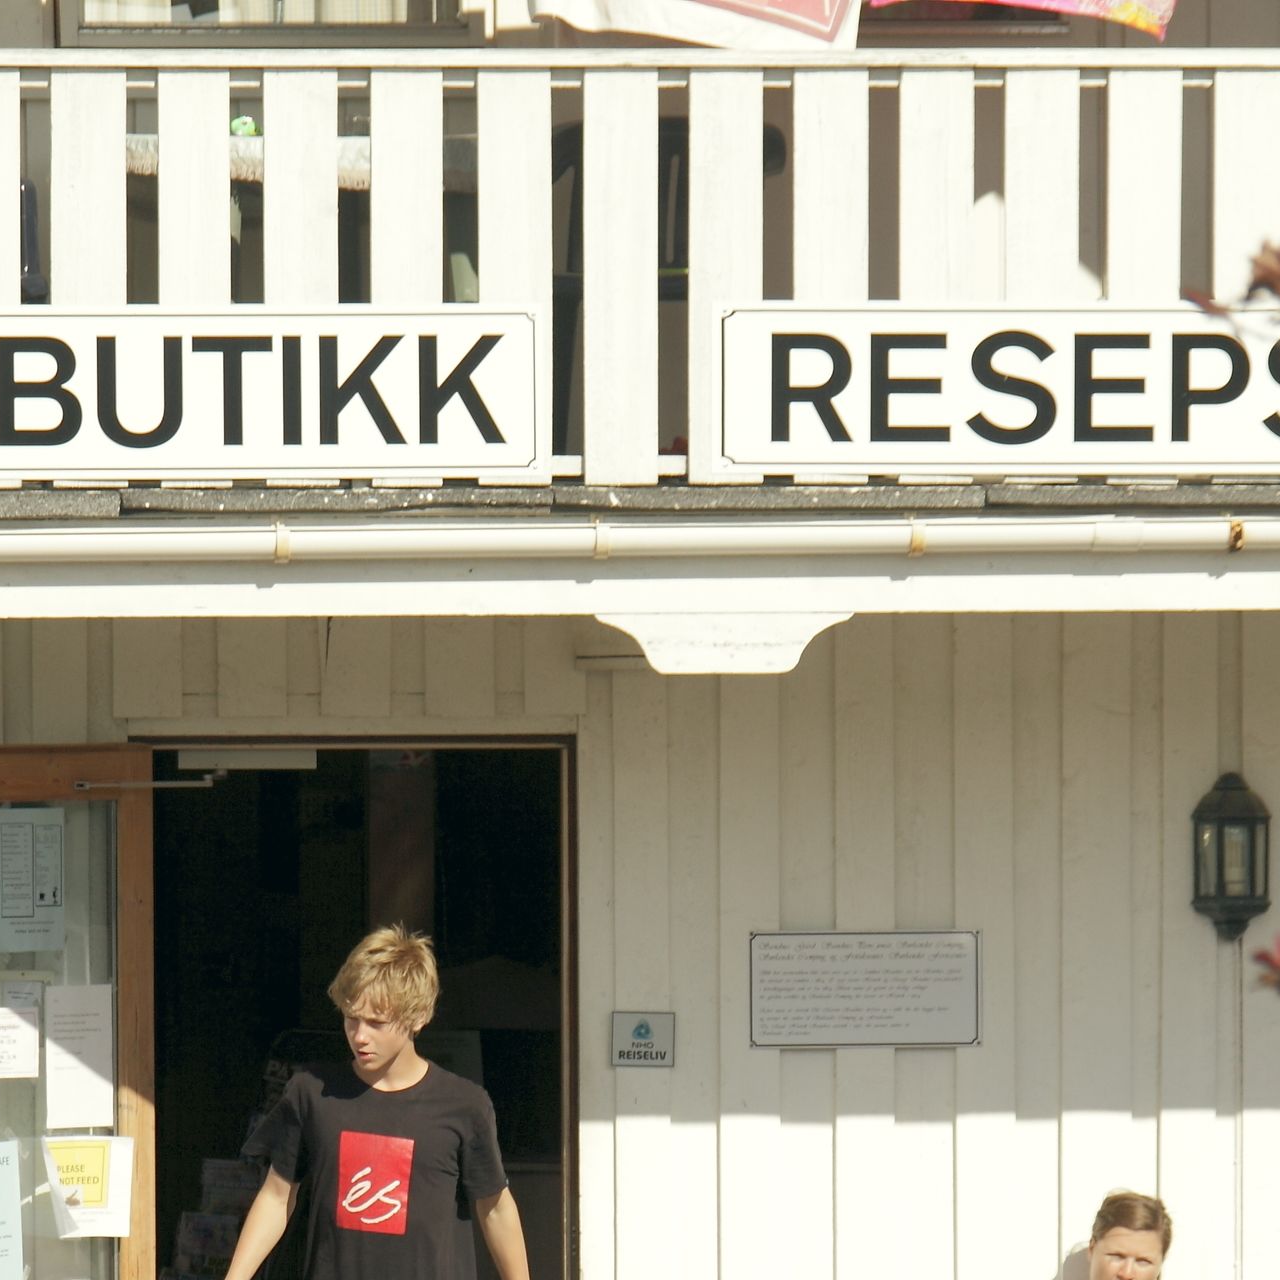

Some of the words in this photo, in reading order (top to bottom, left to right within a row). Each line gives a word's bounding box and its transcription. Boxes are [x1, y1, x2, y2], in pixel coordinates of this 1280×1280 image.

[618, 1050, 667, 1061] REISELIV
[56, 1164, 86, 1174] PLEASE
[59, 1176, 76, 1186] NOT
[76, 1175, 100, 1185] FEED
